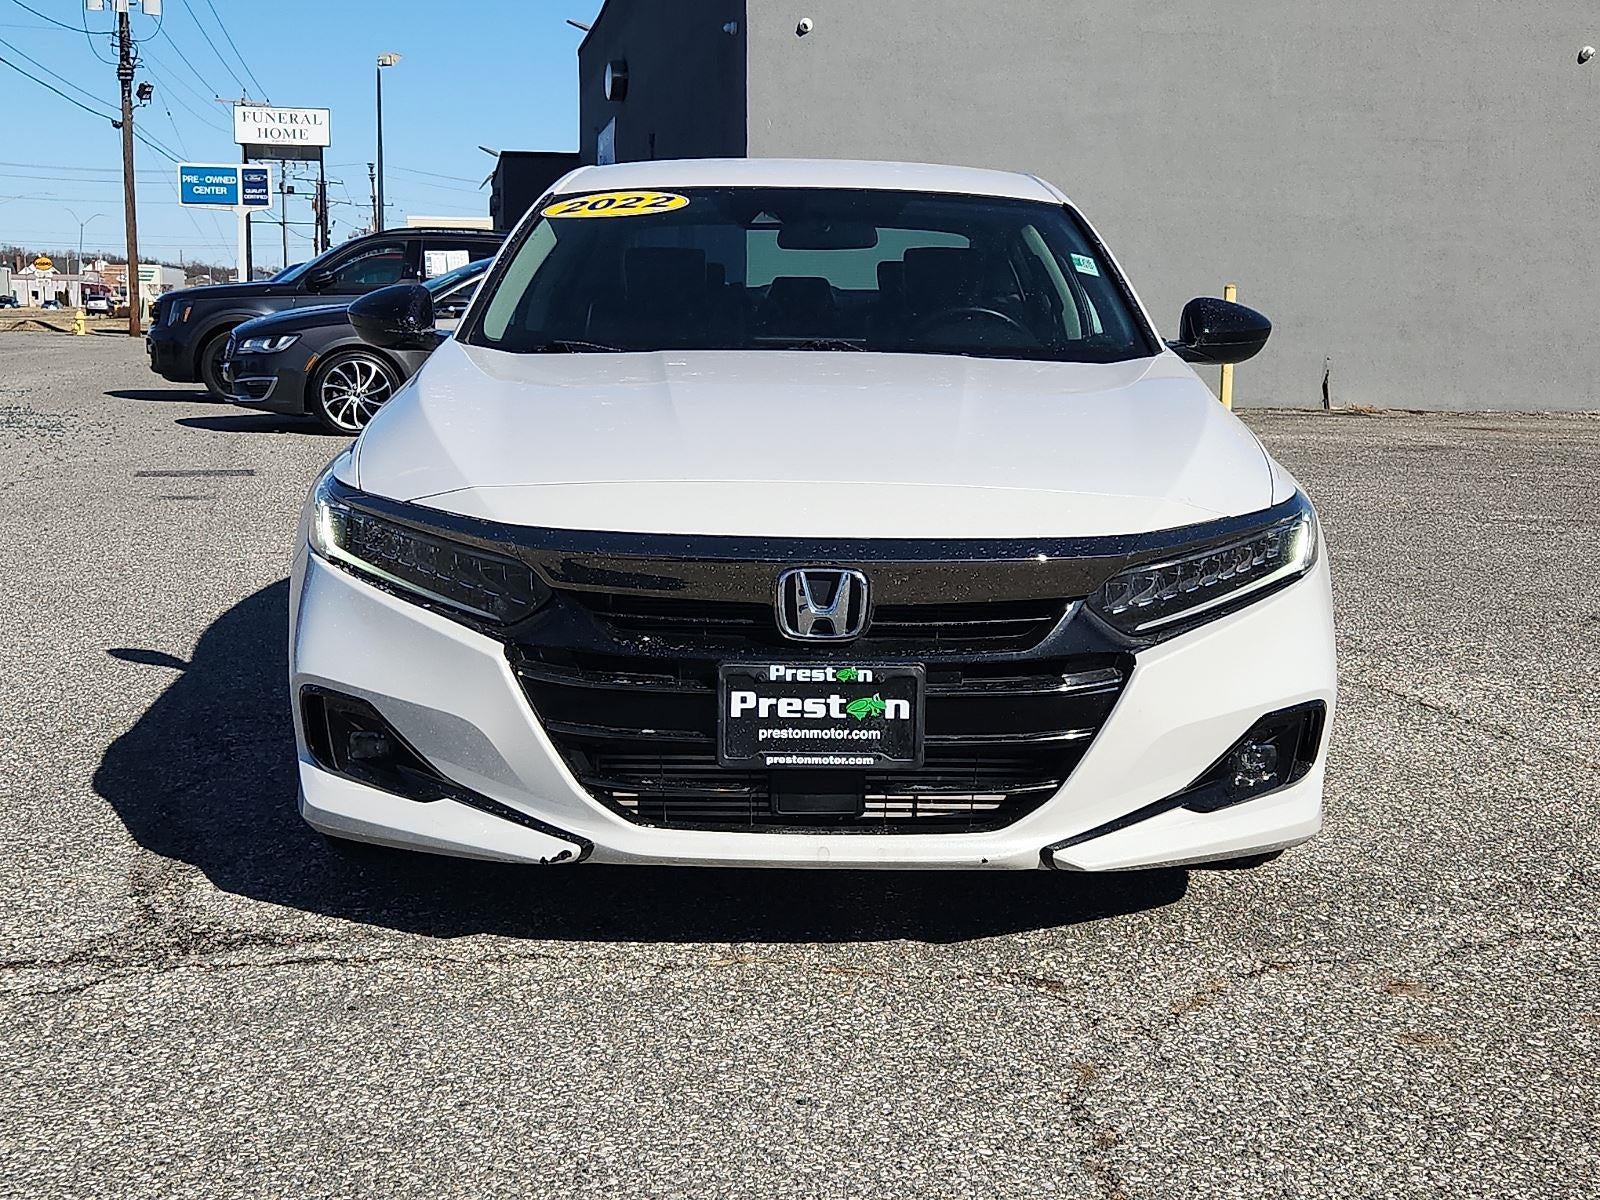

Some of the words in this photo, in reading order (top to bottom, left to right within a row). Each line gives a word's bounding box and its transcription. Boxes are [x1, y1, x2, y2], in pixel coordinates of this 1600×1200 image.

[242, 111, 323, 126] FUNERAL
[257, 127, 309, 141] HOME
[192, 186, 227, 194] CENTER
[556, 195, 675, 214] 2022
[758, 727, 881, 741] prestonmotor.com
[766, 755, 875, 766] prestonmotor.com
